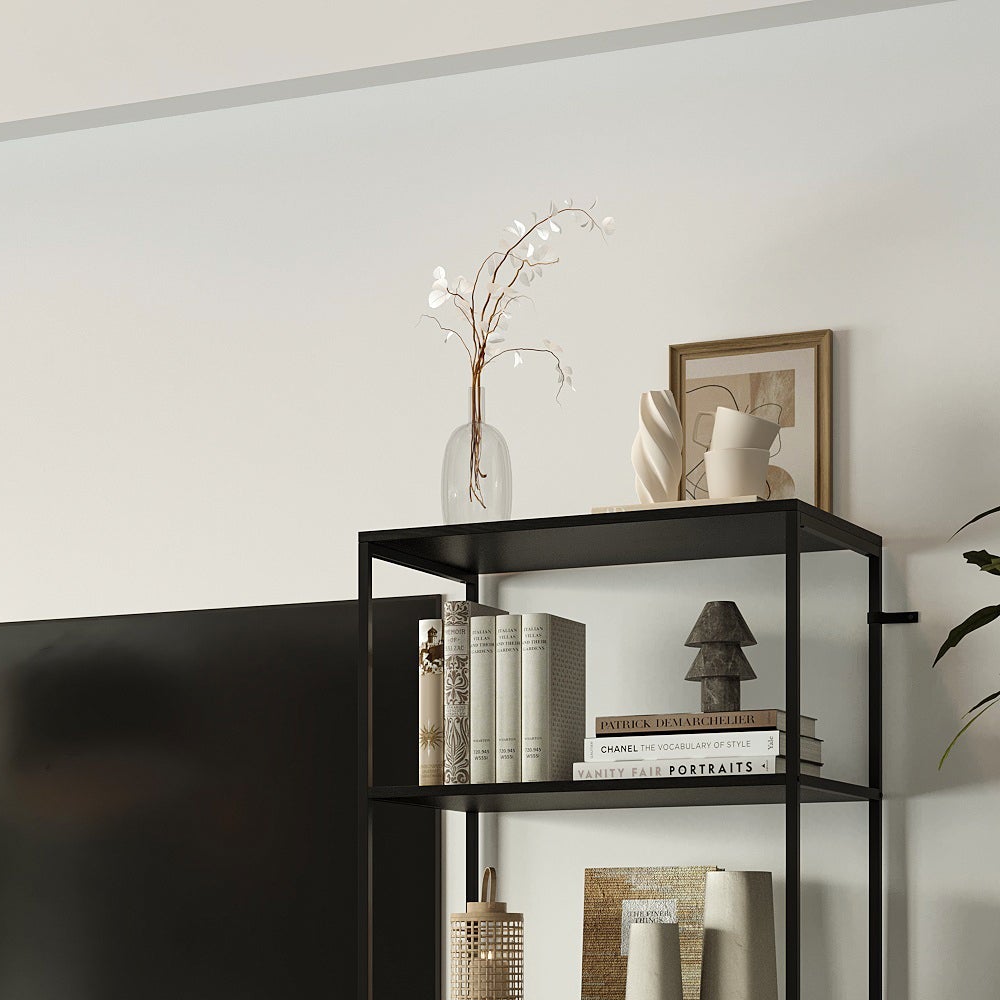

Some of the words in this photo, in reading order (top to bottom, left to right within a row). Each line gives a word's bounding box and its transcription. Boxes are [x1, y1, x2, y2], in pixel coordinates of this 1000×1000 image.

[600, 719, 651, 730] PATRICK
[656, 715, 756, 728] DEMARCHELIER
[600, 745, 638, 754] CHANEL
[640, 744, 656, 752] THE
[657, 741, 711, 751] VOCABULARY
[713, 741, 725, 749] OF
[726, 740, 751, 748] STYLE
[578, 768, 625, 779] VANITY
[632, 766, 662, 777] FAIR
[669, 761, 753, 775] PORTRAITS
